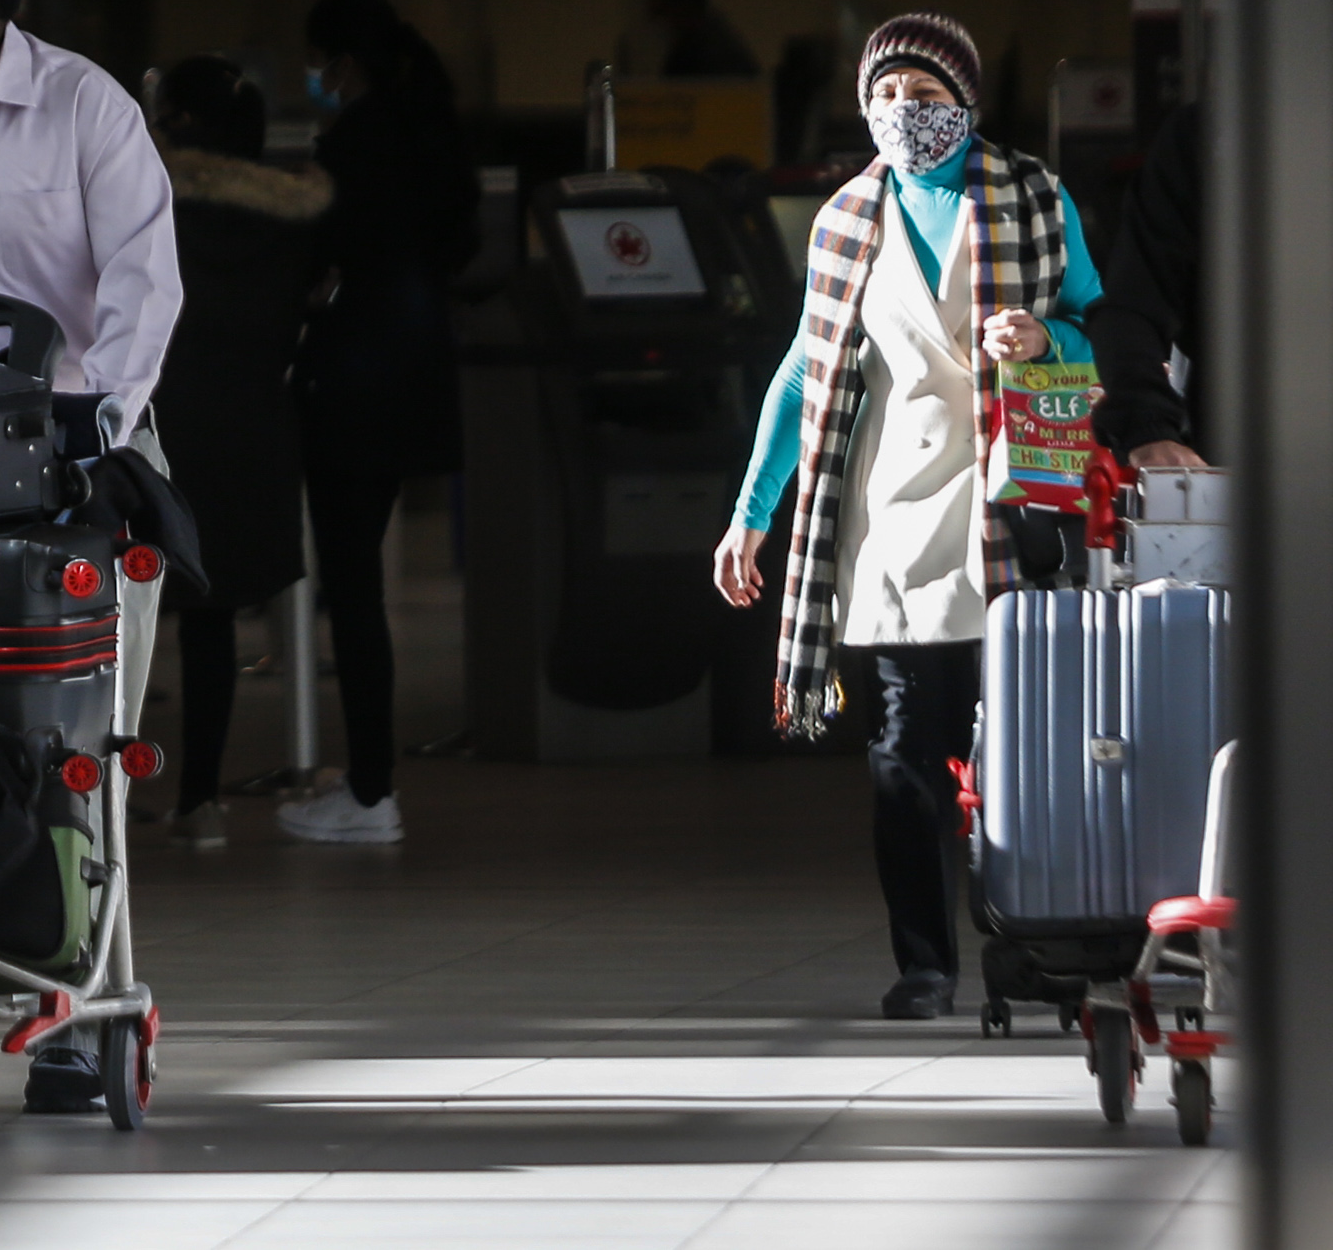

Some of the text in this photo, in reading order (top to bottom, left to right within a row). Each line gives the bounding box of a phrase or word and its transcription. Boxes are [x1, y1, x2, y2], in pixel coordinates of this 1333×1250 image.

[1053, 374, 1090, 385] YOUR
[1038, 426, 1091, 442] MERR
[1009, 447, 1087, 470] CHRISTM
